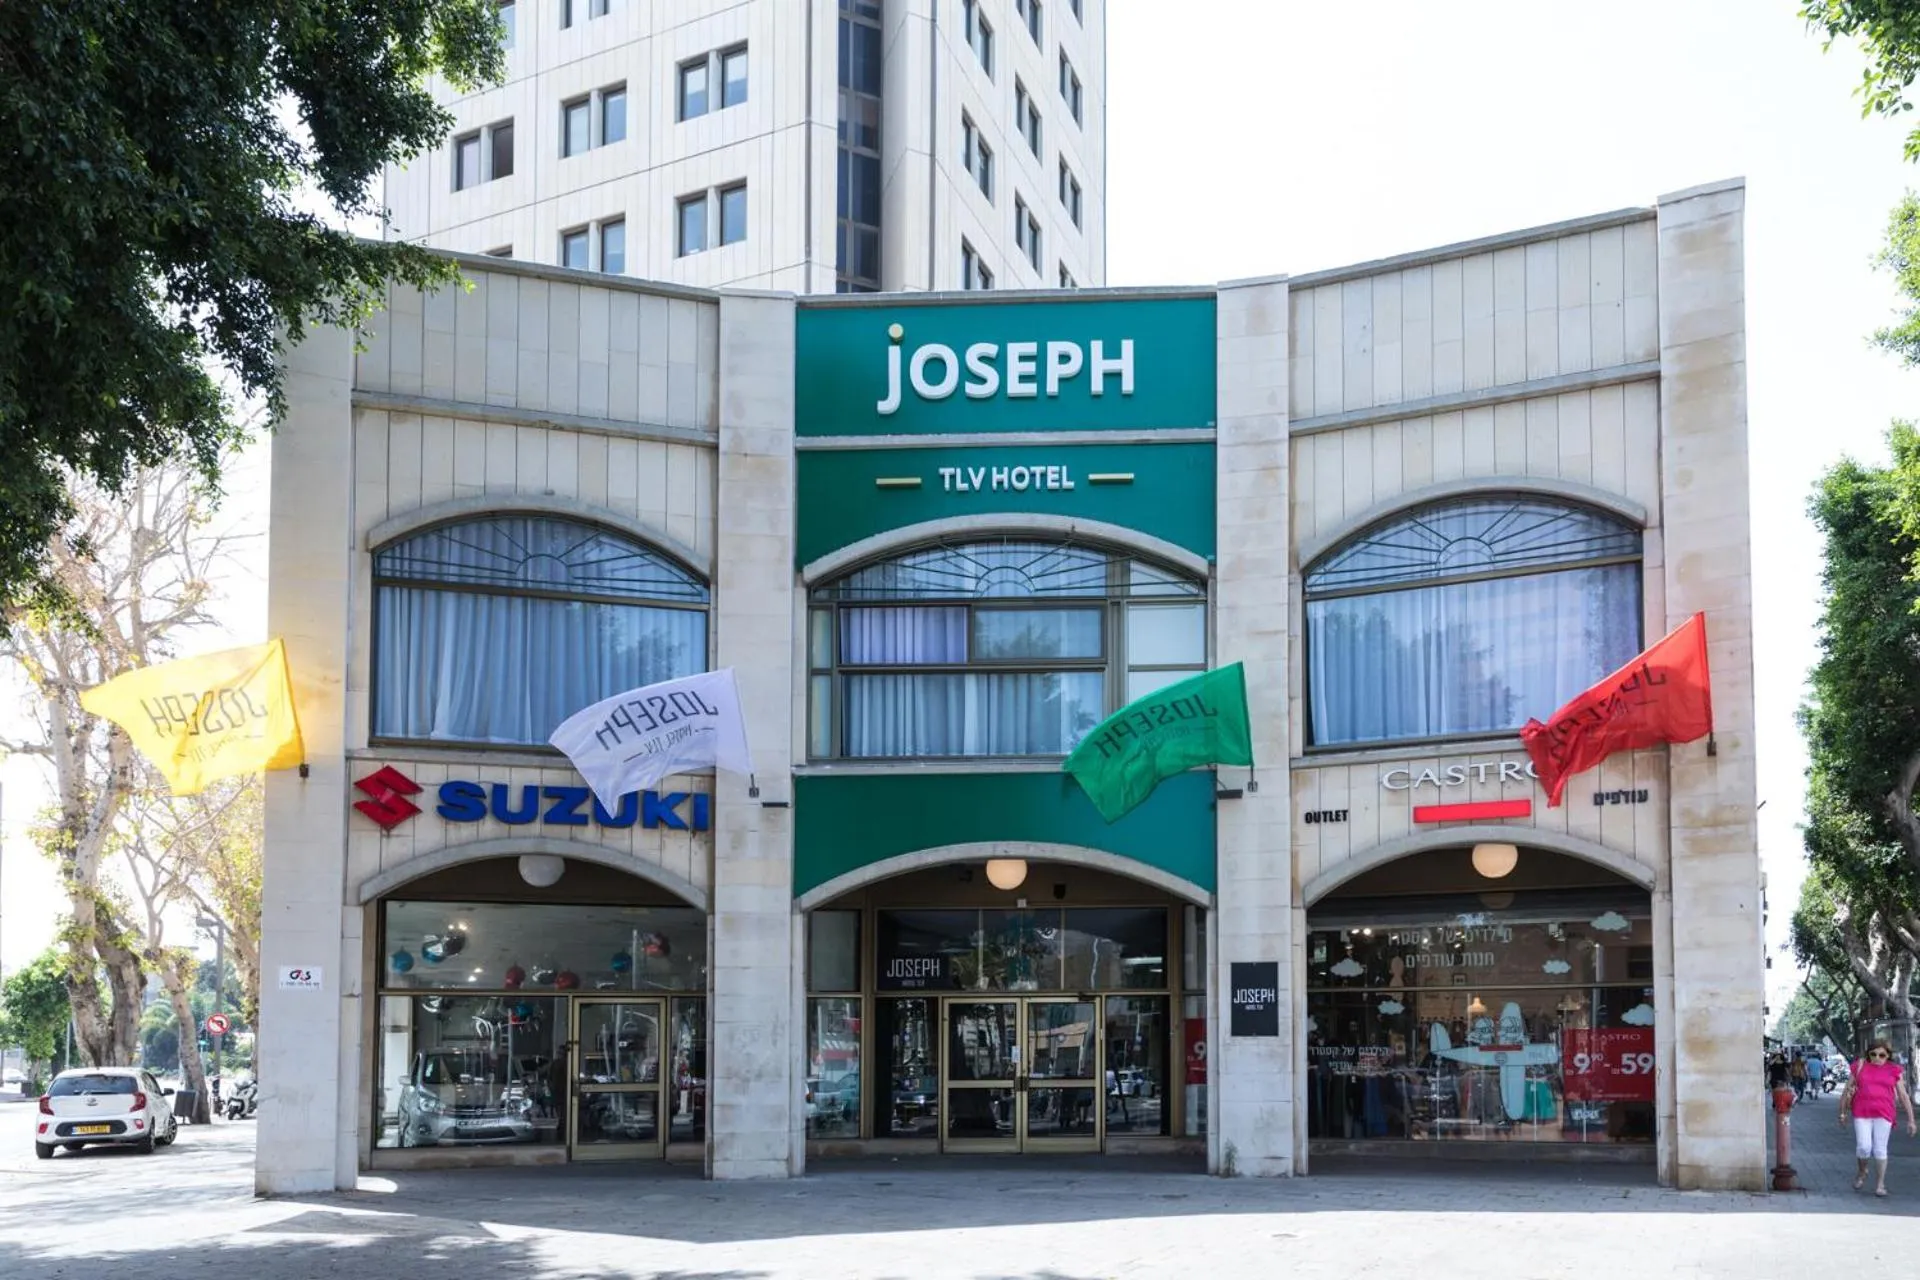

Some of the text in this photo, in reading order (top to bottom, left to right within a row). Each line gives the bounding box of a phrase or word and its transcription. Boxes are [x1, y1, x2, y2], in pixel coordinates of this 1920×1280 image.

[938, 465, 1075, 491] TLV HOTEL
[436, 780, 710, 832] SUZUKI
[1304, 809, 1349, 824] OUTLET
[886, 958, 941, 978] JOSEPH
[1233, 987, 1275, 1004] JOSEPH
